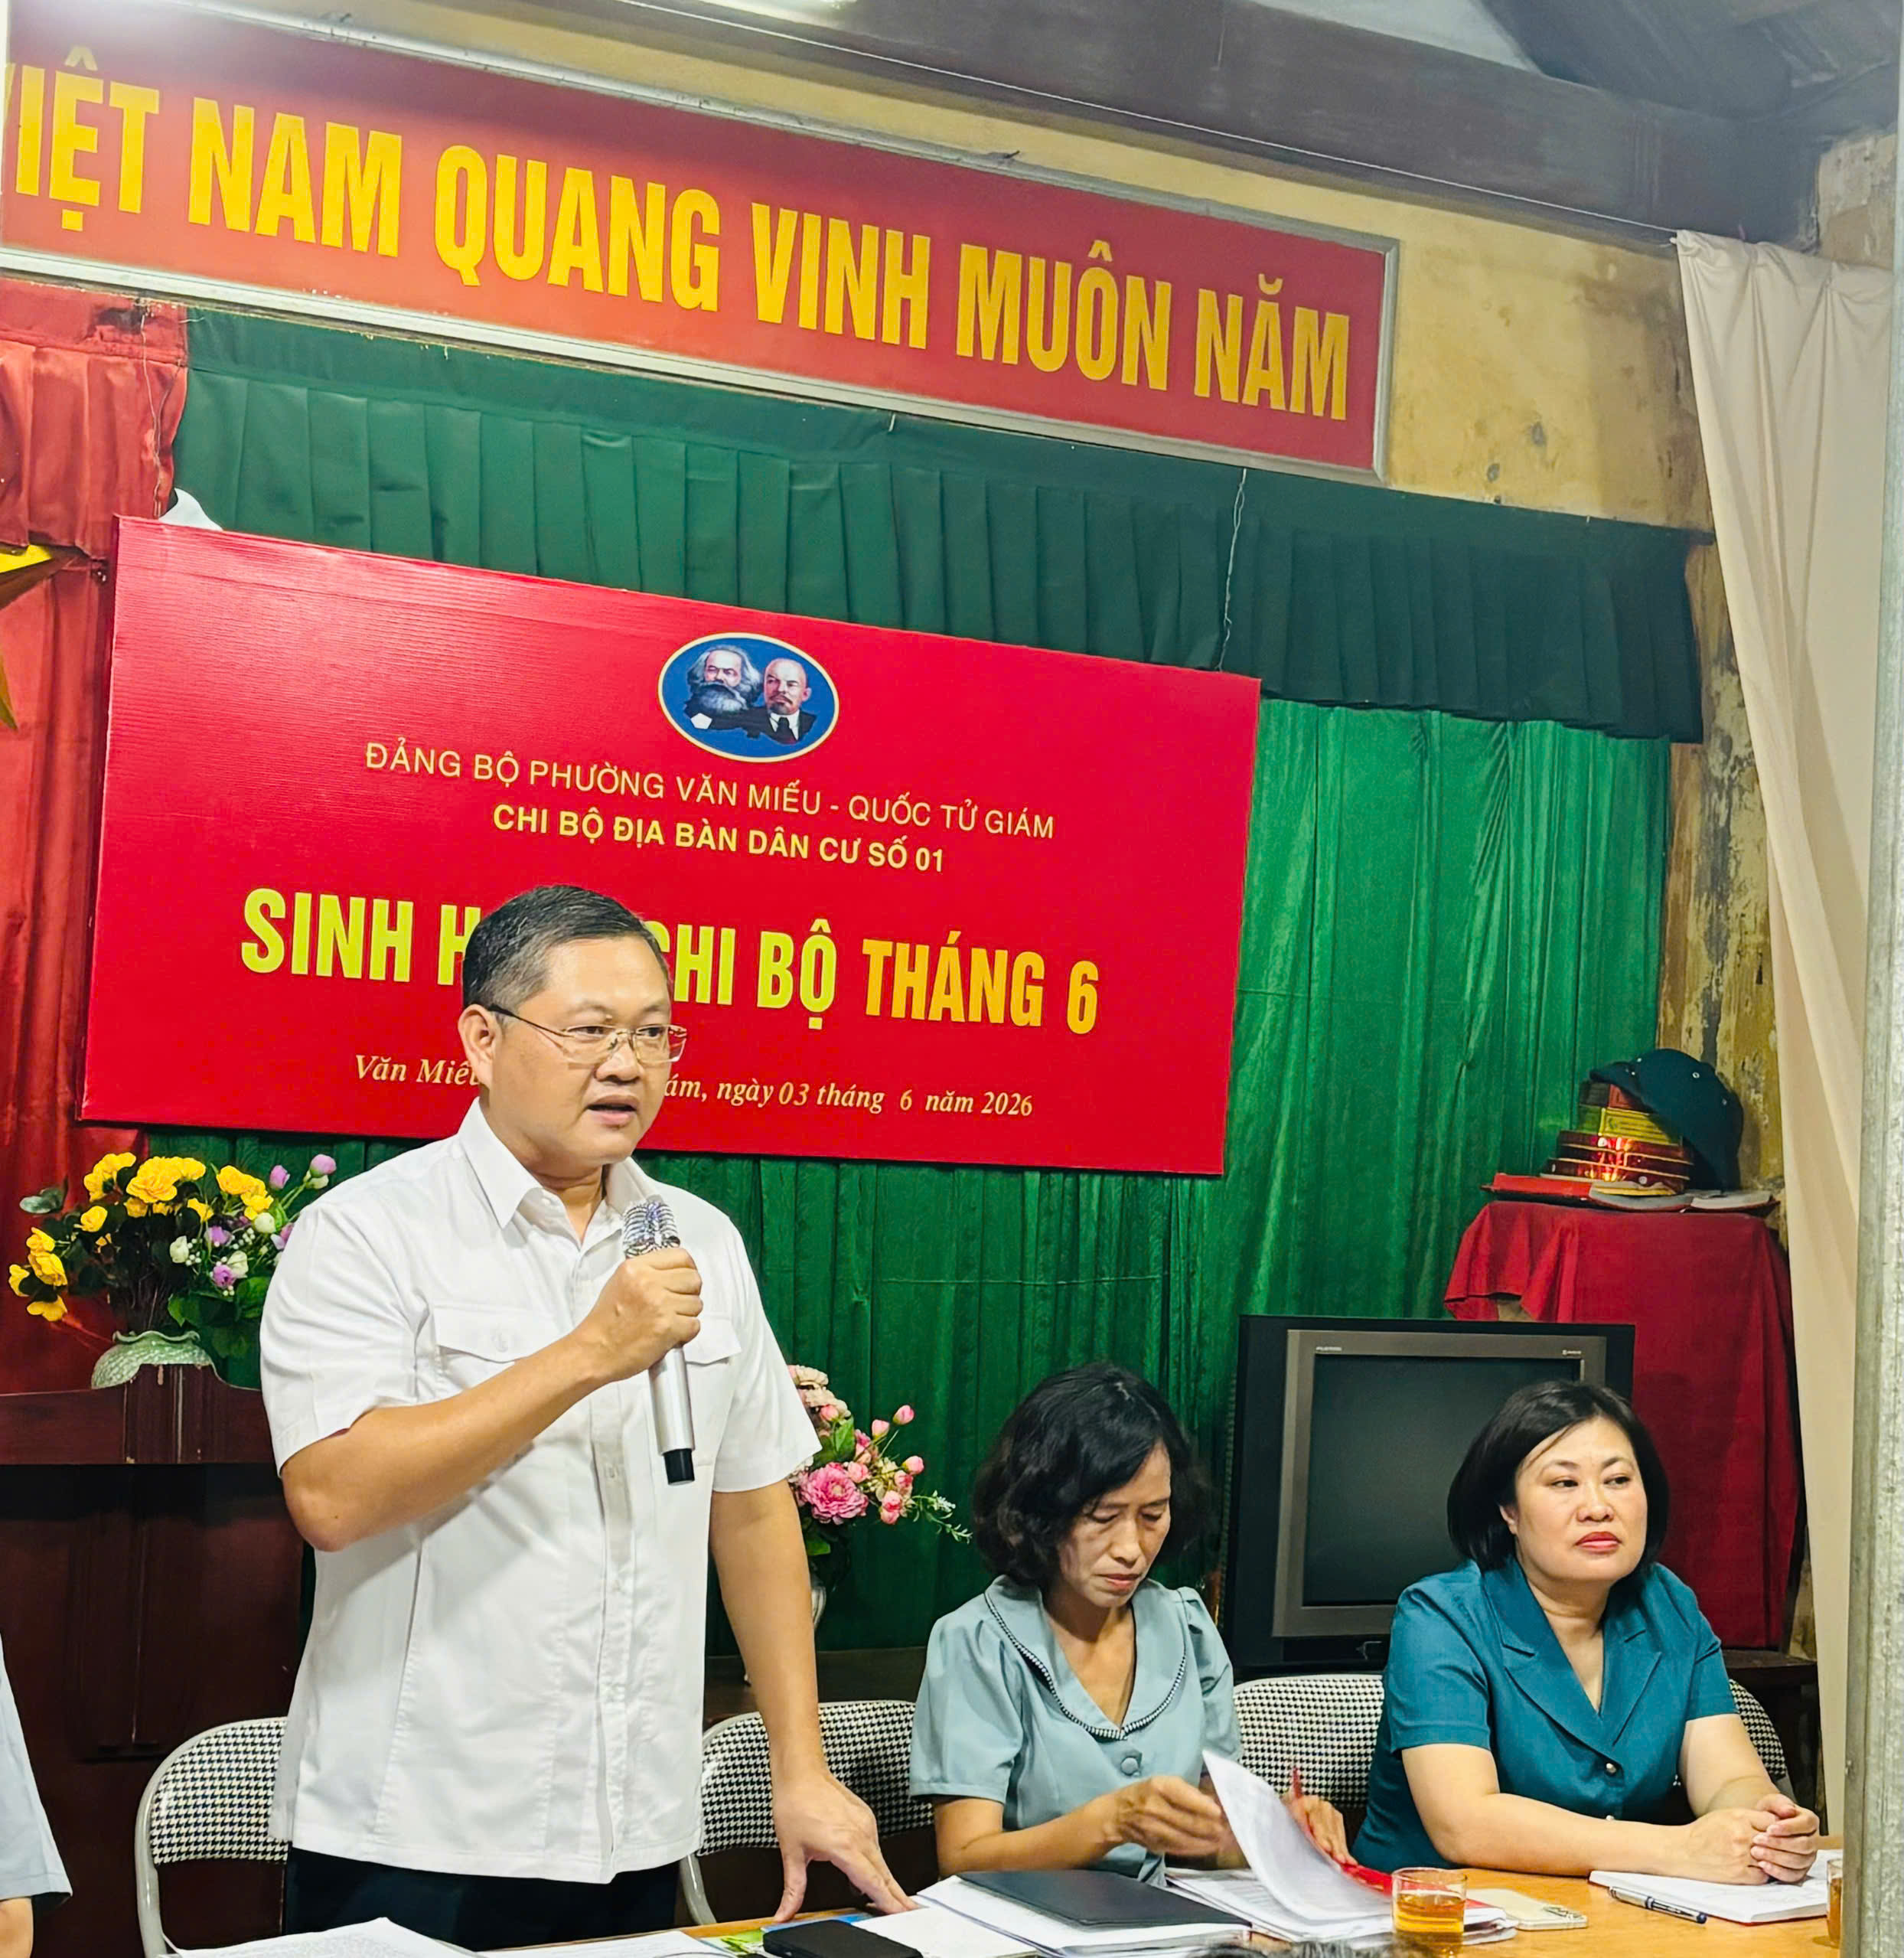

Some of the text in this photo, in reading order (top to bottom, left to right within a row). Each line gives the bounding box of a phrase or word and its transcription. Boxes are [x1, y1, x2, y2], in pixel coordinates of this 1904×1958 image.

[5, 45, 1350, 421] IỆT NAM QUANG VINH MUÔN NĂM
[365, 736, 461, 777] ĐẢNG
[474, 750, 520, 788] BỘ
[530, 760, 664, 798] PHƯỜNG
[676, 773, 737, 806] VĂN
[748, 779, 821, 815] MIẾU
[848, 791, 931, 827] QUỐC
[940, 798, 978, 831] TỬ
[984, 807, 1054, 839] GIÁM
[493, 804, 943, 873] CHI BỘ ĐỊA BÀN DÂN CƯ SỐ 01
[241, 887, 414, 983] SINH
[756, 918, 837, 1030] BỘ
[862, 930, 1045, 1027] THÁNG
[1067, 960, 1099, 1034] 6
[356, 1055, 407, 1082] Văn
[716, 1078, 774, 1108] ngày
[778, 1082, 810, 1106] 03
[817, 1082, 885, 1114] tháng
[899, 1089, 913, 1111] 6
[925, 1090, 974, 1113] năm
[980, 1091, 1032, 1116] 2026
